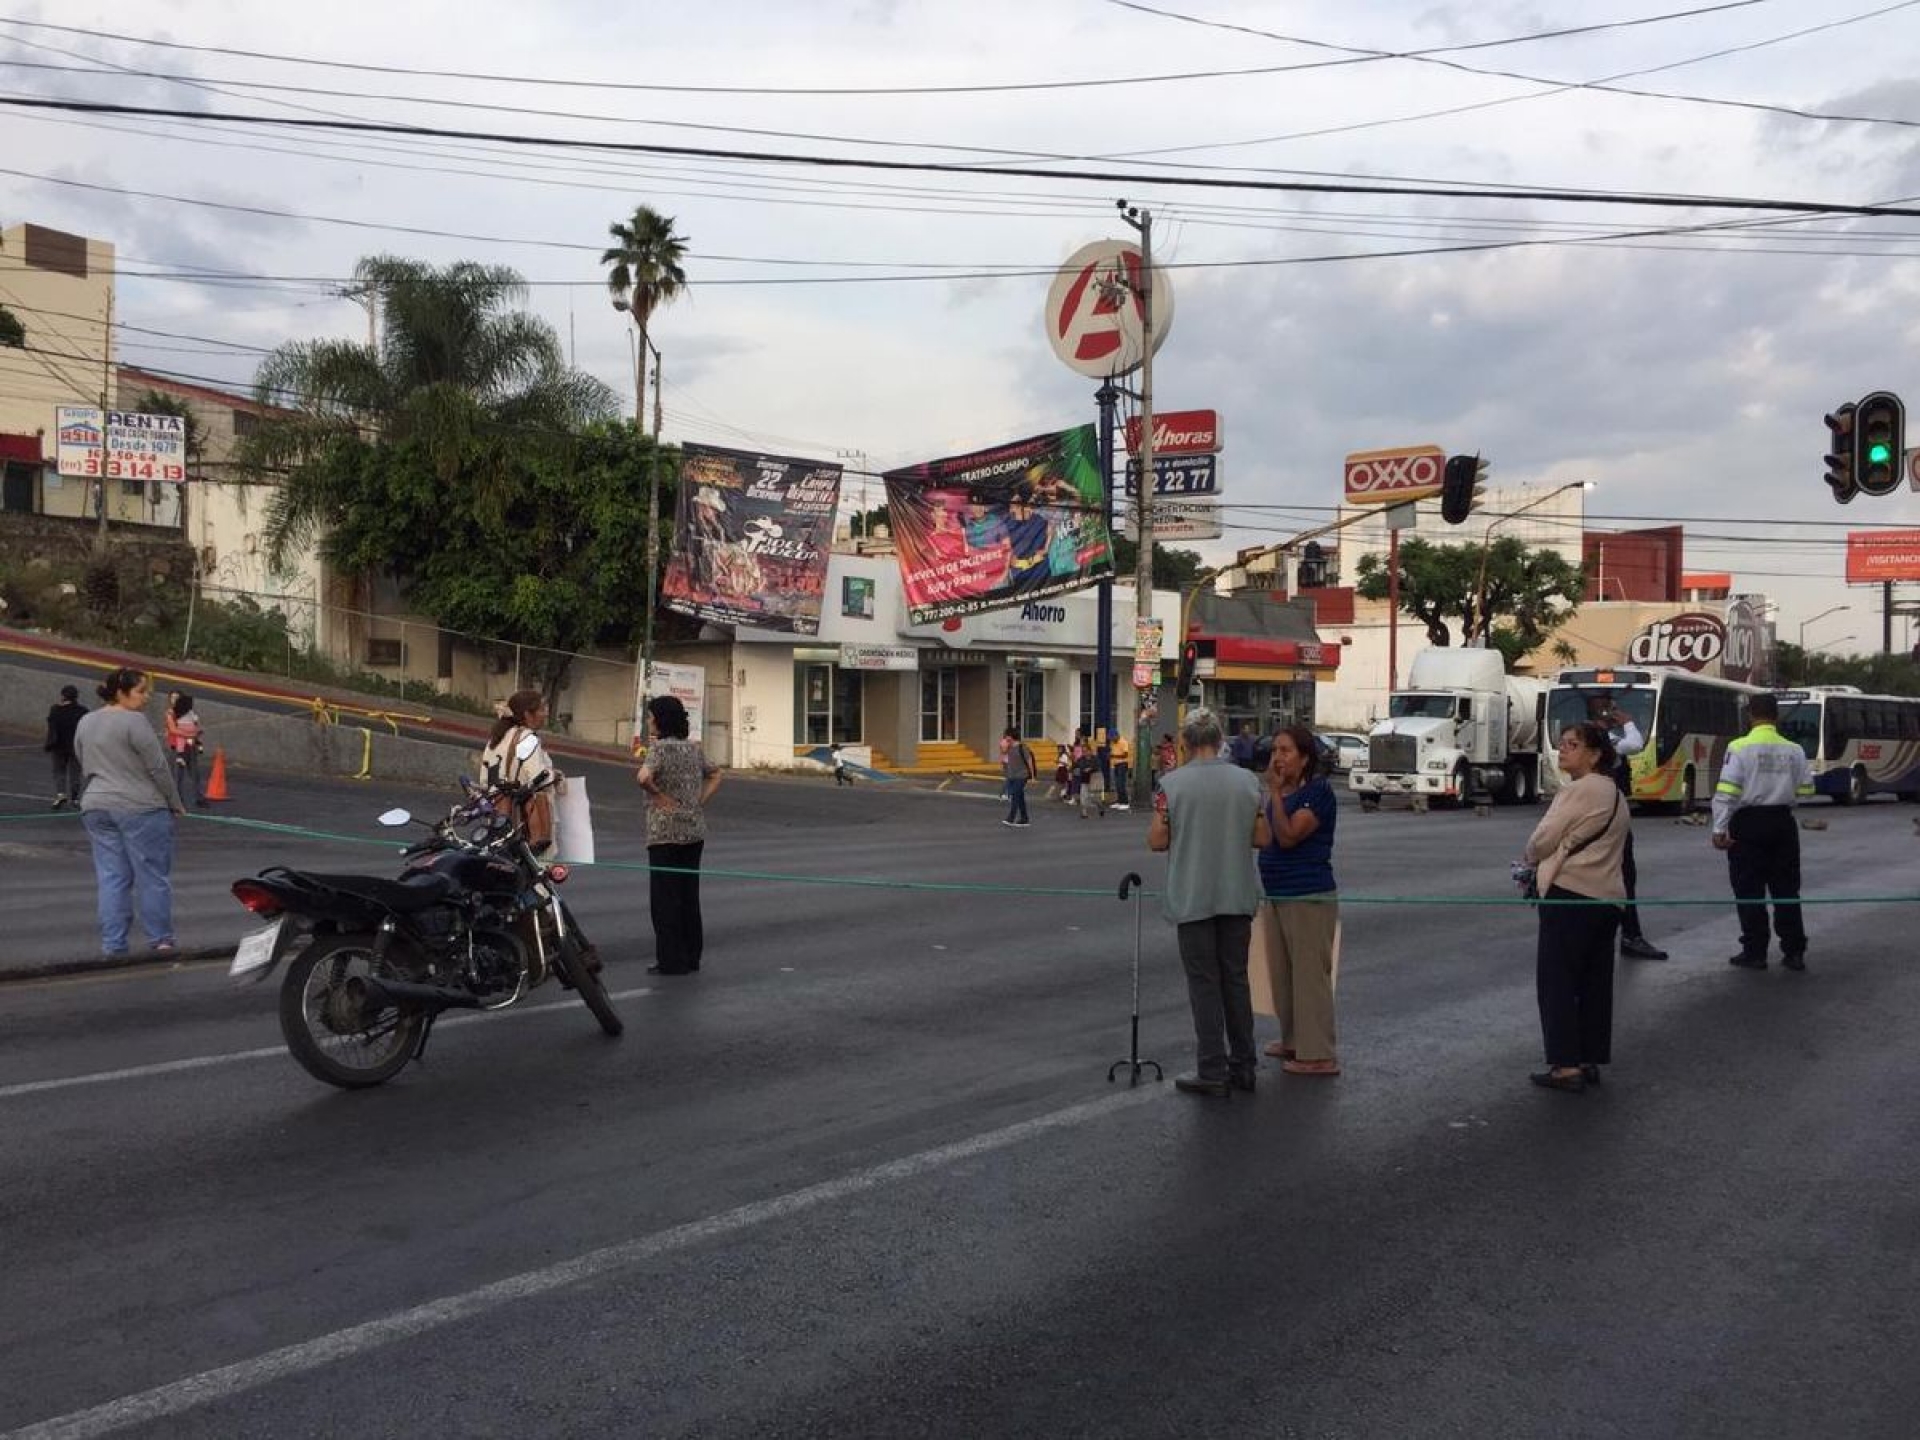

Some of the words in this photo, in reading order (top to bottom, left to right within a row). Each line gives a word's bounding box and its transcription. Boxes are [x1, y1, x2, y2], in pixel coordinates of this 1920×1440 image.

[107, 412, 180, 430] RENTA
[993, 457, 1030, 476] OCAMPO
[1349, 457, 1437, 492] OXXO
[756, 469, 782, 489] 22
[1165, 471, 1185, 492] 22
[1190, 469, 1211, 489] 77
[1021, 602, 1065, 622] Ahorro
[1631, 623, 1721, 664] dico
